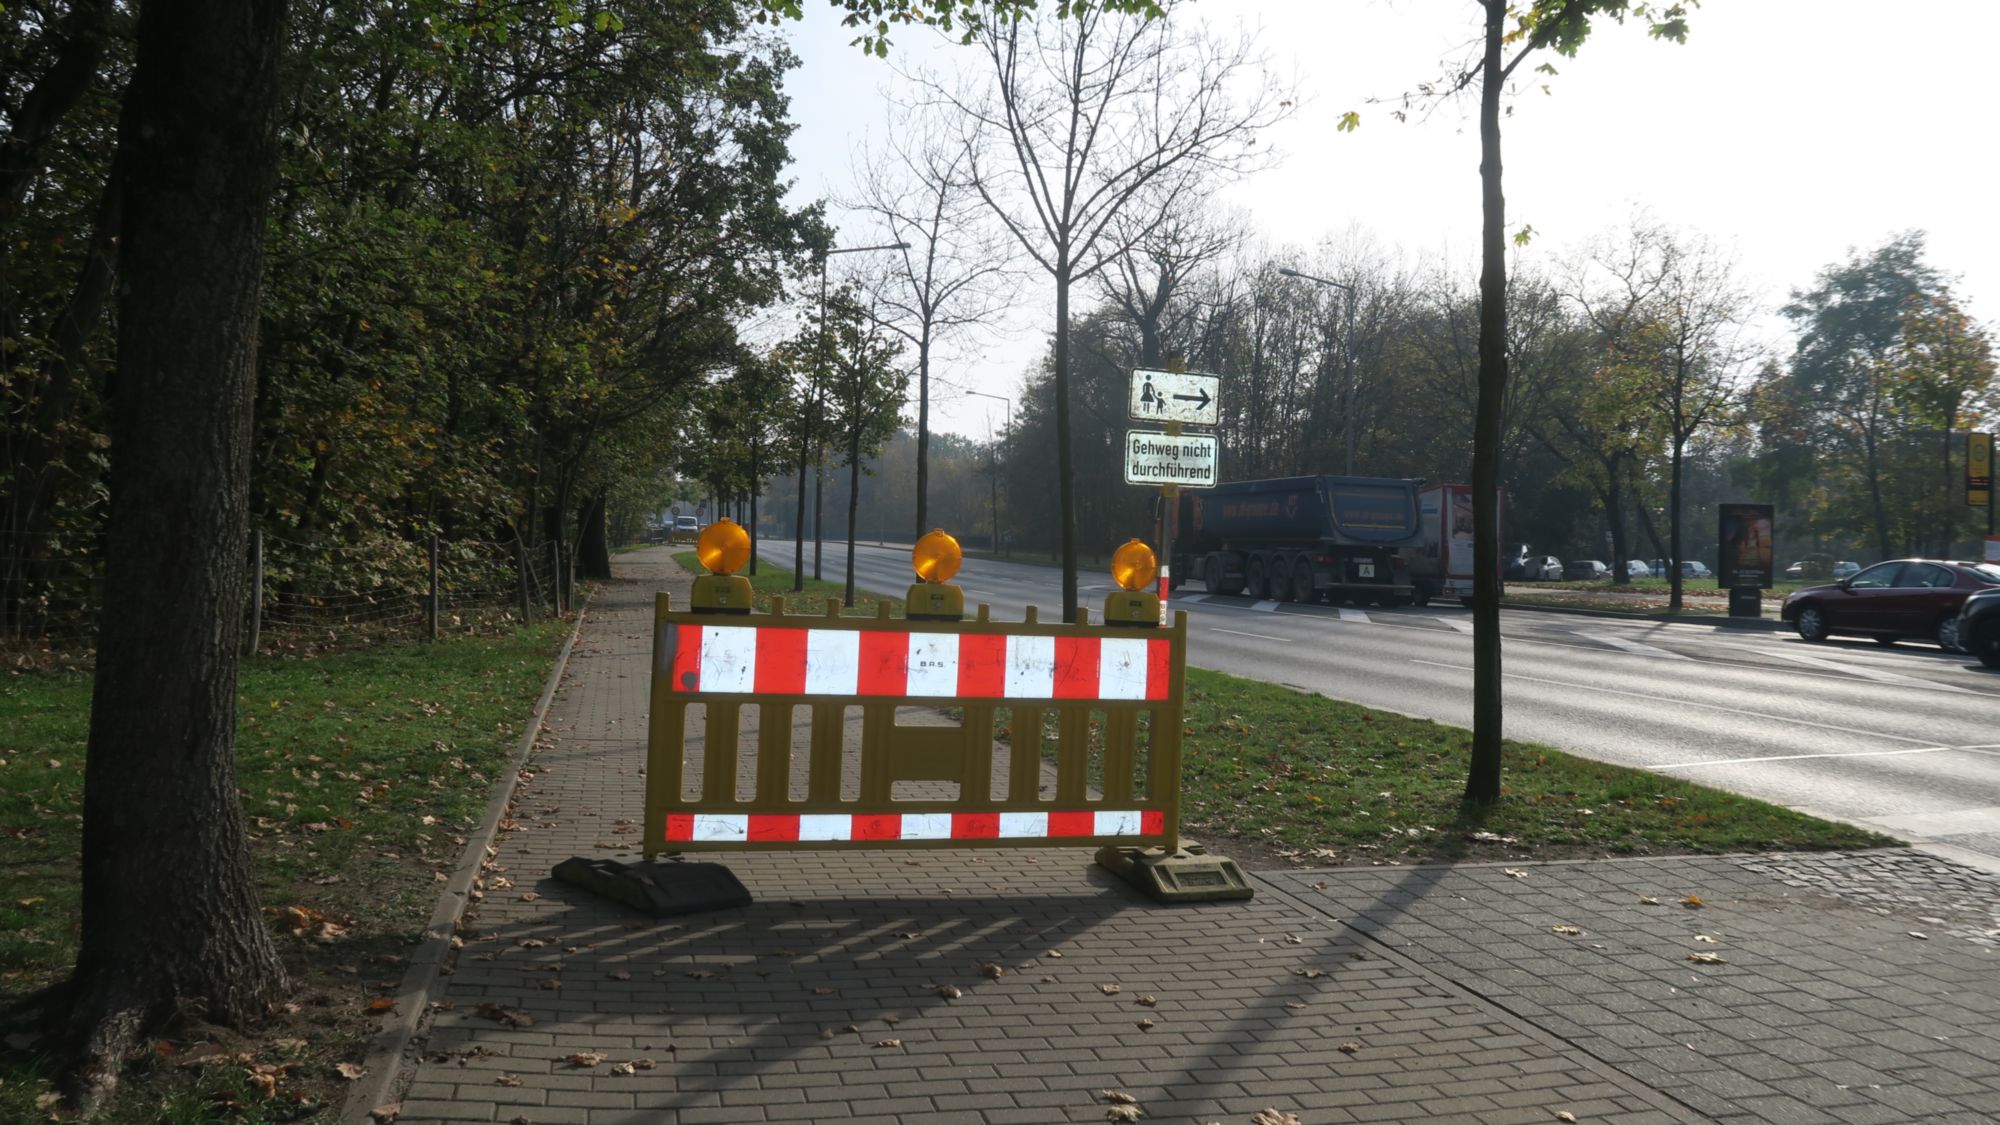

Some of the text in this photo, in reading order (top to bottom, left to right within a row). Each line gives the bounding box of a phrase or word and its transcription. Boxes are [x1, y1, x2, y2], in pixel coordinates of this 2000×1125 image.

[1132, 439, 1212, 460] Gehweg nicht
[1132, 461, 1211, 479] durchführend
